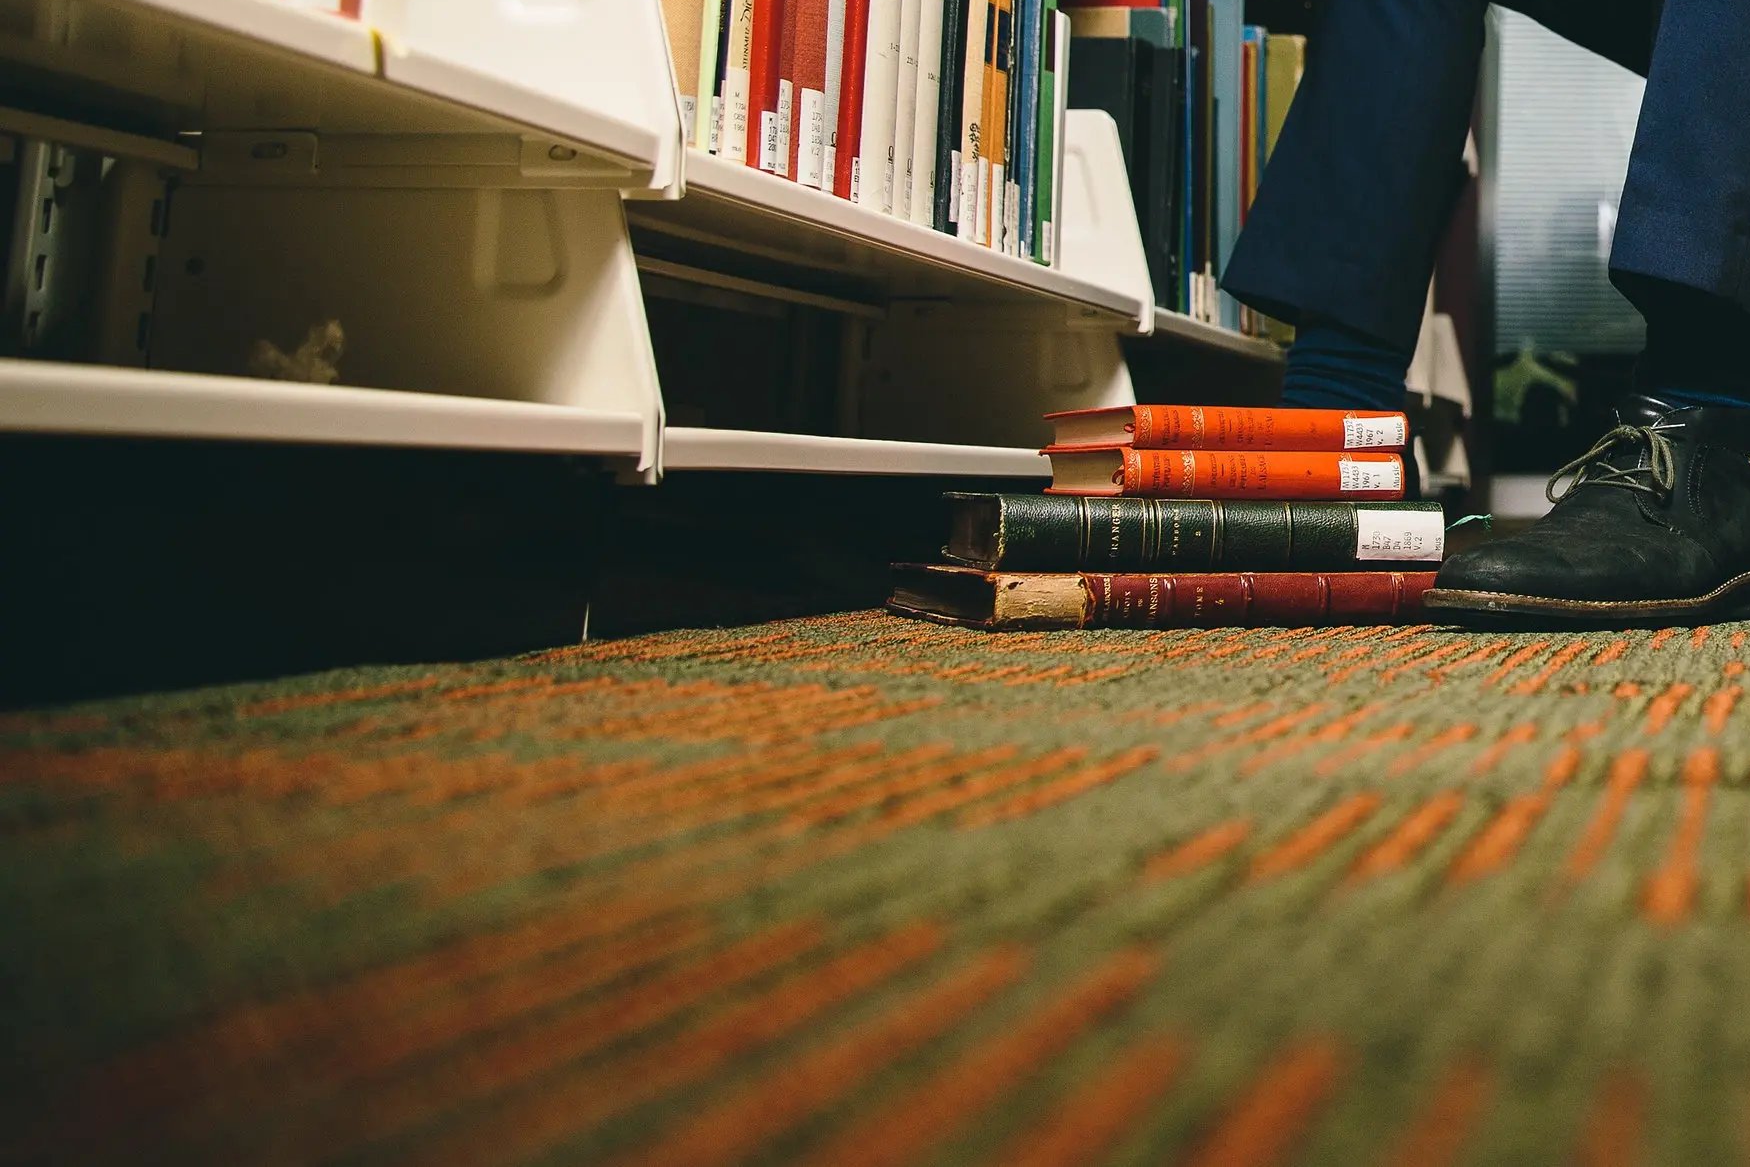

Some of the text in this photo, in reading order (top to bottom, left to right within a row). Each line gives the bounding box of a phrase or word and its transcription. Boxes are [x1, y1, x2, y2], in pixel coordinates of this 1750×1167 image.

[741, 0, 752, 23] Die
[1345, 420, 1354, 446] M 1732
[1355, 422, 1363, 446] W4433
[1366, 428, 1374, 445] 1967
[1340, 462, 1350, 488] M 1732
[1362, 472, 1370, 488] 1967
[1392, 464, 1400, 488] Music
[1382, 535, 1391, 550] B47
[1392, 540, 1400, 550] D4
[1403, 530, 1412, 550] 1869
[1413, 536, 1422, 550] V.2
[1434, 536, 1442, 550] MUS
